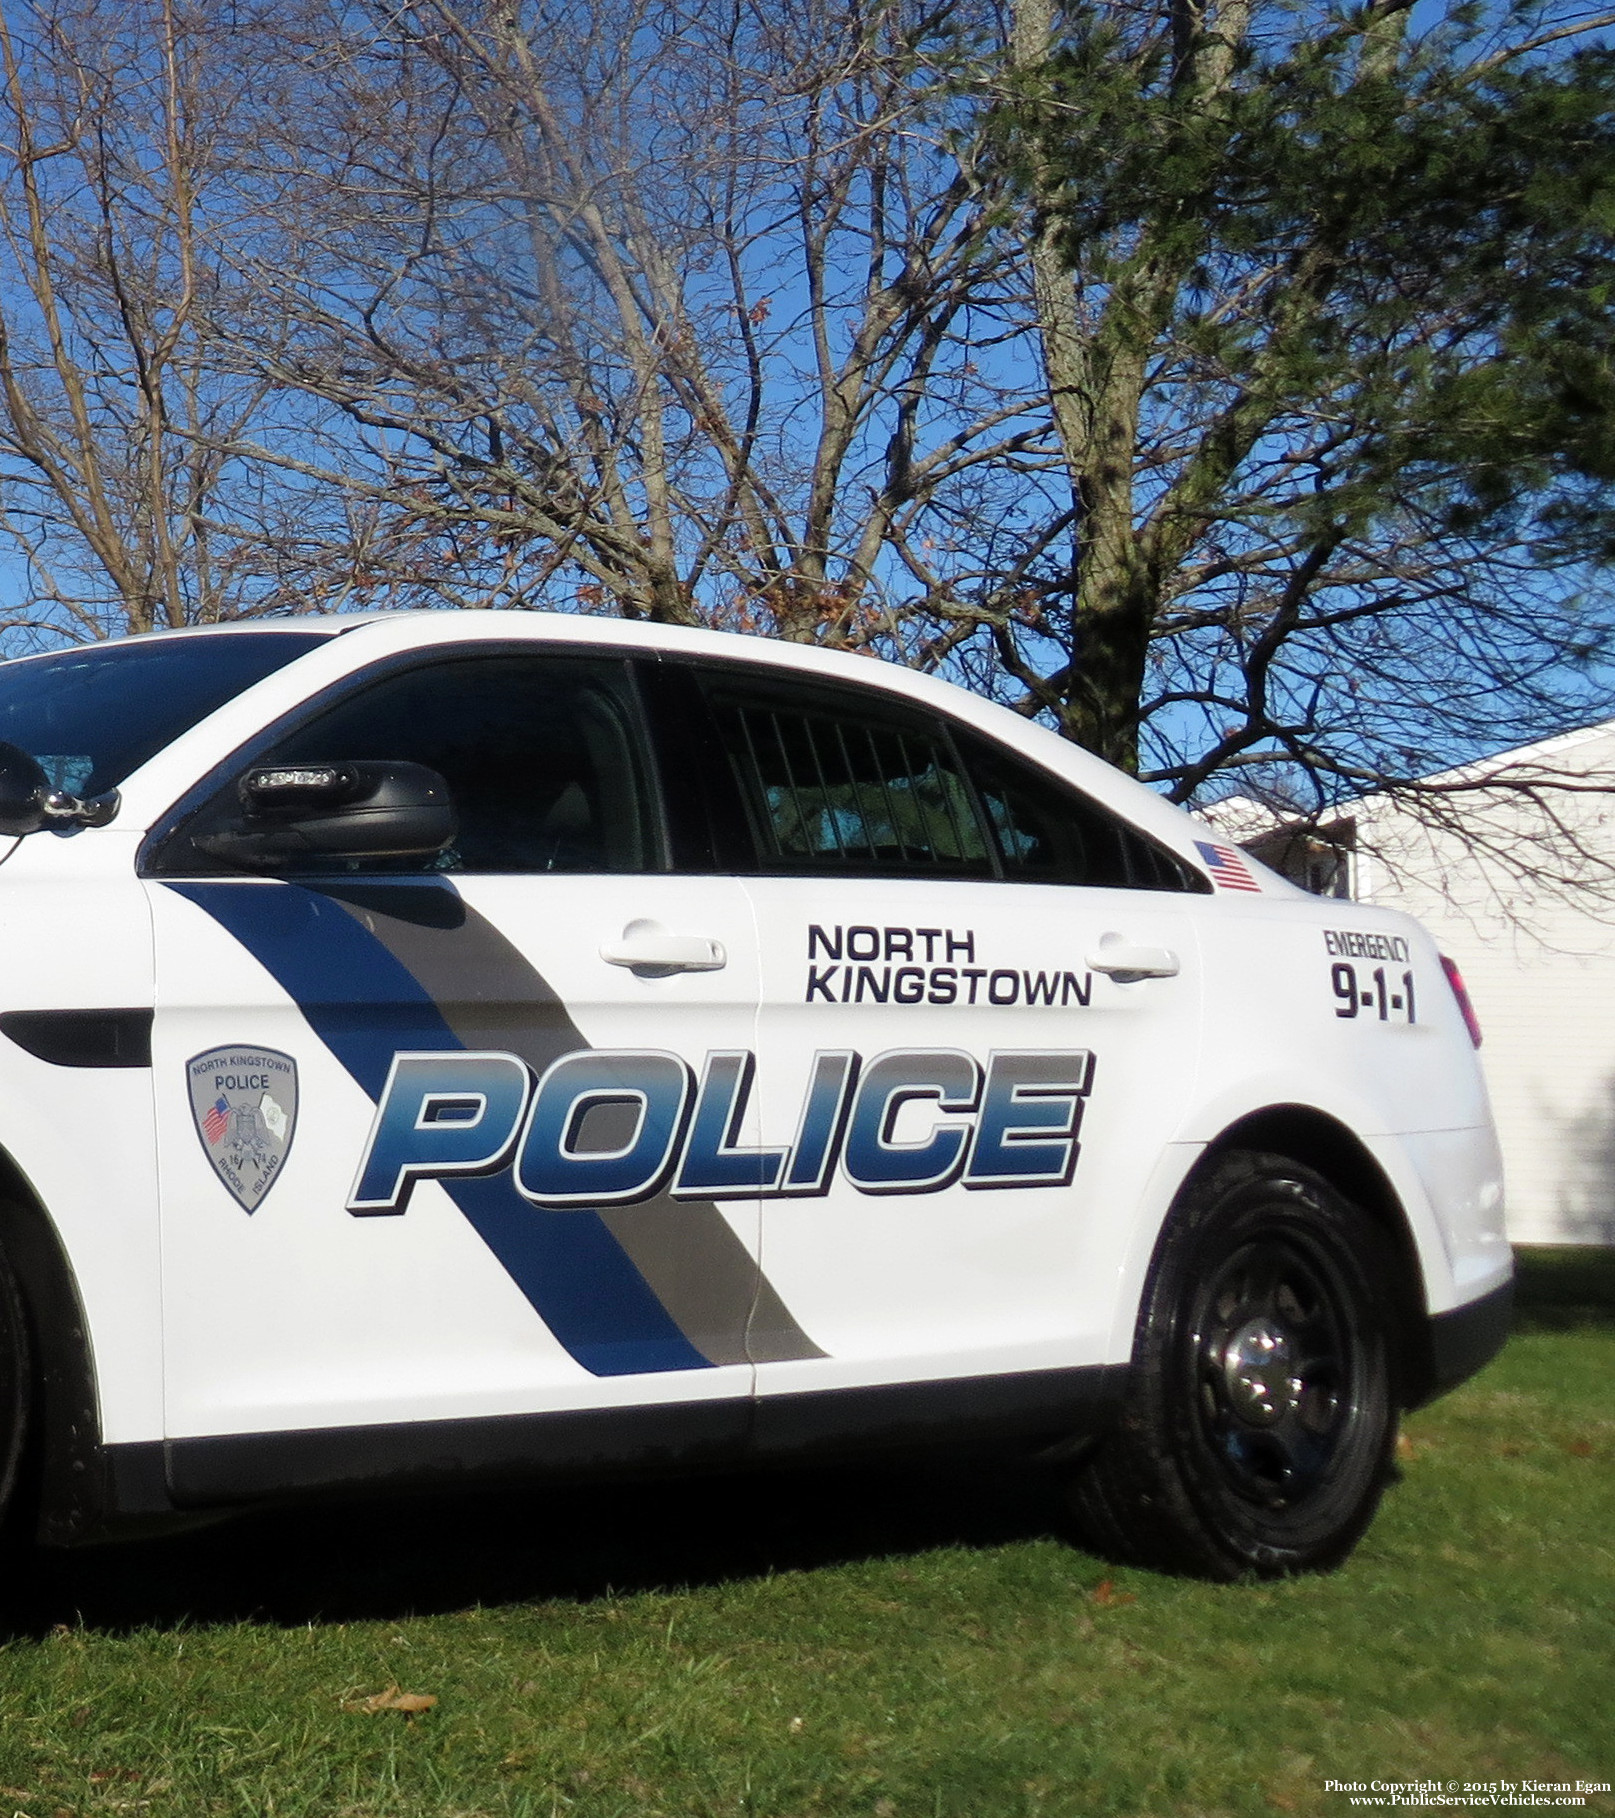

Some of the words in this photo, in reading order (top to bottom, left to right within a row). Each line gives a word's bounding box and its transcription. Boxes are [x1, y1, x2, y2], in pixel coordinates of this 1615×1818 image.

[807, 924, 975, 964] NORTH
[1322, 929, 1411, 963] EMERGENCY
[805, 965, 1092, 1007] KINGSTOWN
[1330, 962, 1416, 1025] 9-1-1
[192, 1058, 228, 1075] NORTH
[229, 1055, 291, 1074] KINGSTOWN
[214, 1074, 270, 1090] POLICE
[345, 1047, 1099, 1217] POLICE
[218, 1158, 246, 1195] RHODE
[252, 1154, 279, 1195] ISLAND
